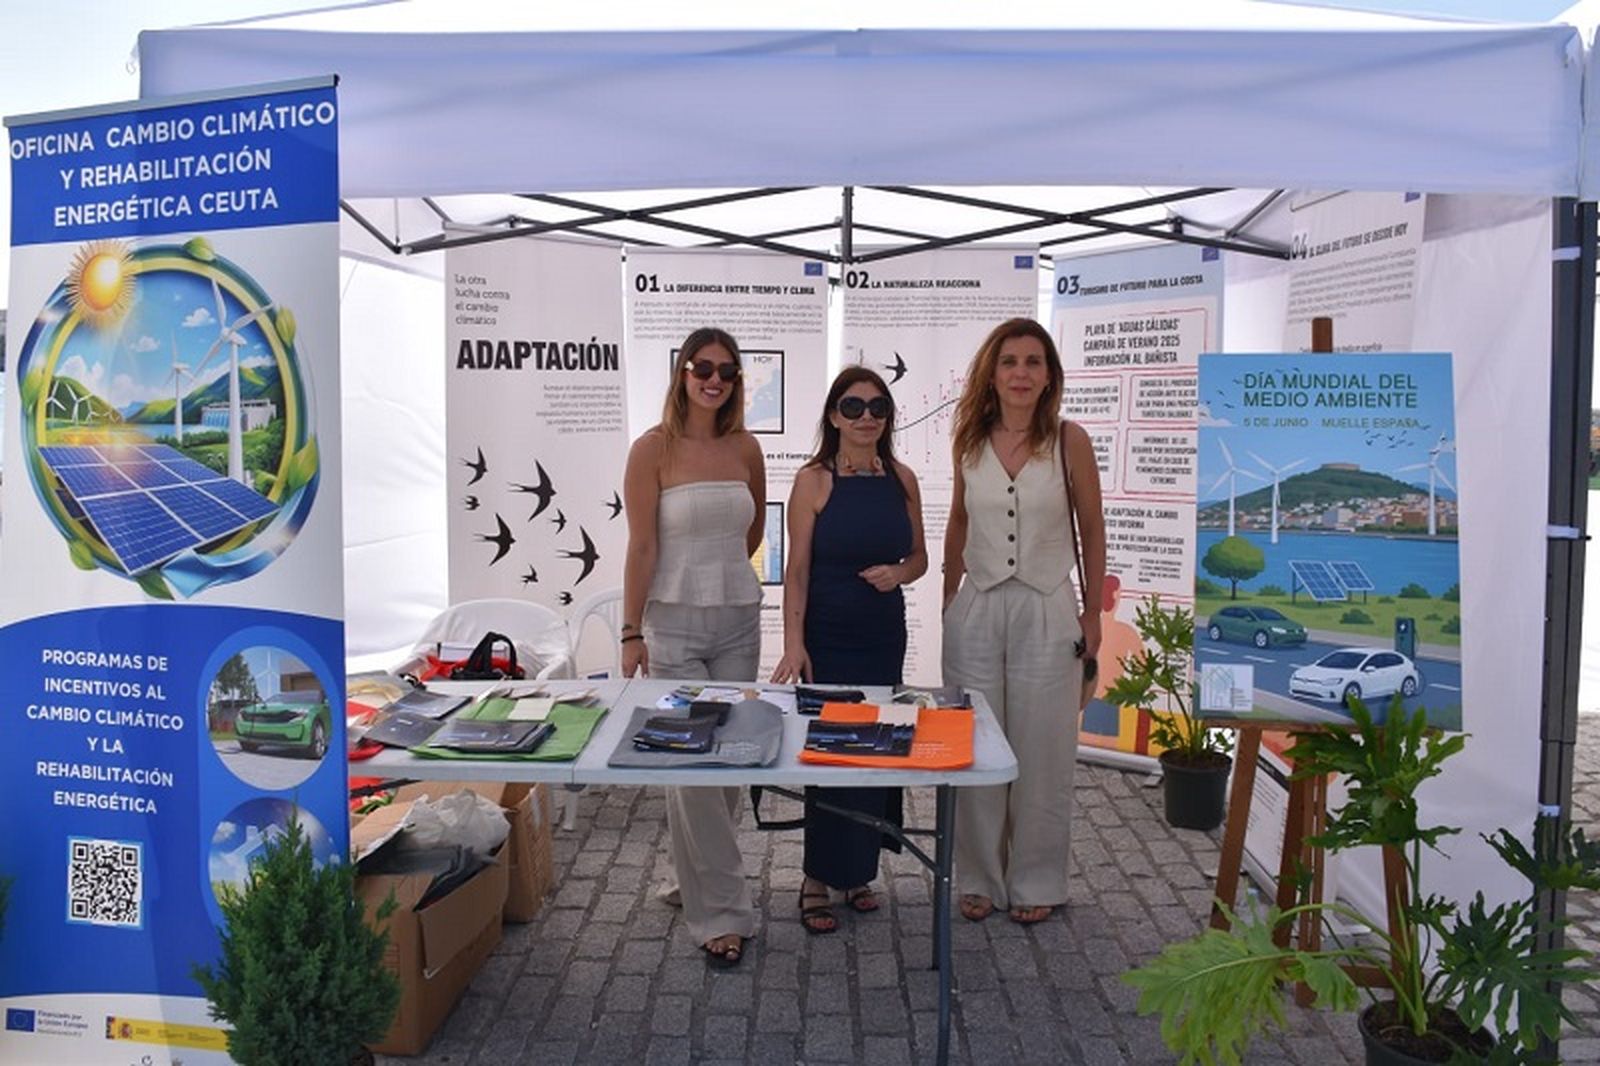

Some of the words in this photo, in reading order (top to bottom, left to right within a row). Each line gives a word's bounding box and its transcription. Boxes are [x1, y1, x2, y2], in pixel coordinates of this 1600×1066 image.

[10, 131, 94, 160] OFICINA
[106, 119, 194, 148] CAMBIO
[202, 101, 335, 137] CLIMÁTICO
[60, 170, 73, 190] Y
[81, 146, 272, 188] REHABILITACIÓN
[54, 194, 192, 227] ENERGÉTICA
[199, 187, 279, 214] CEUTA
[635, 273, 660, 292] 01
[664, 284, 675, 293] LA
[676, 284, 723, 294] DIFERENCIA
[725, 284, 750, 294] ENTRE
[752, 285, 781, 294] TIEMPO
[783, 285, 789, 294] Y
[790, 286, 815, 295] CLIMA
[846, 271, 870, 289] 02
[871, 281, 882, 289] LA
[884, 279, 934, 289] NATURALEZA
[935, 279, 981, 289] REACCIONA
[1056, 275, 1080, 295] 03
[1148, 279, 1169, 289] PARA
[1170, 278, 1179, 287] LA
[1179, 275, 1204, 285] COSTA
[455, 287, 480, 298] lucha
[482, 290, 510, 300] contra
[466, 302, 499, 312] cambio
[1085, 324, 1106, 337] PLAYA
[1107, 322, 1117, 334] DE
[1117, 337, 1127, 349] DE
[1128, 335, 1159, 349] VERANO
[1160, 334, 1181, 347] 2025
[1083, 351, 1131, 367] INFORMACIÓN
[1133, 353, 1143, 364] AL
[1244, 372, 1276, 389] DÍA
[1282, 373, 1372, 390] MUNDIAL
[1379, 374, 1418, 390] DEL
[1243, 392, 1309, 407] MEDIO
[1314, 392, 1417, 408] AMBIENTE
[1244, 418, 1250, 427] 5
[1253, 418, 1270, 427] DE
[1272, 418, 1309, 427] JUNIO
[1321, 418, 1370, 428] MUELLE
[1373, 417, 1419, 429] ESPAÑA
[42, 649, 143, 669] PROGRAMAS
[147, 655, 168, 671] DE
[44, 677, 141, 698] INCENTIVOS
[145, 684, 166, 700] AL
[26, 705, 90, 723] CAMBIO
[95, 708, 183, 730] CLIMÁTICO
[87, 737, 98, 751] Y
[103, 738, 124, 754] LA
[36, 761, 173, 787] REHABILITACIÓN
[54, 791, 157, 814] ENERGÉTICA
